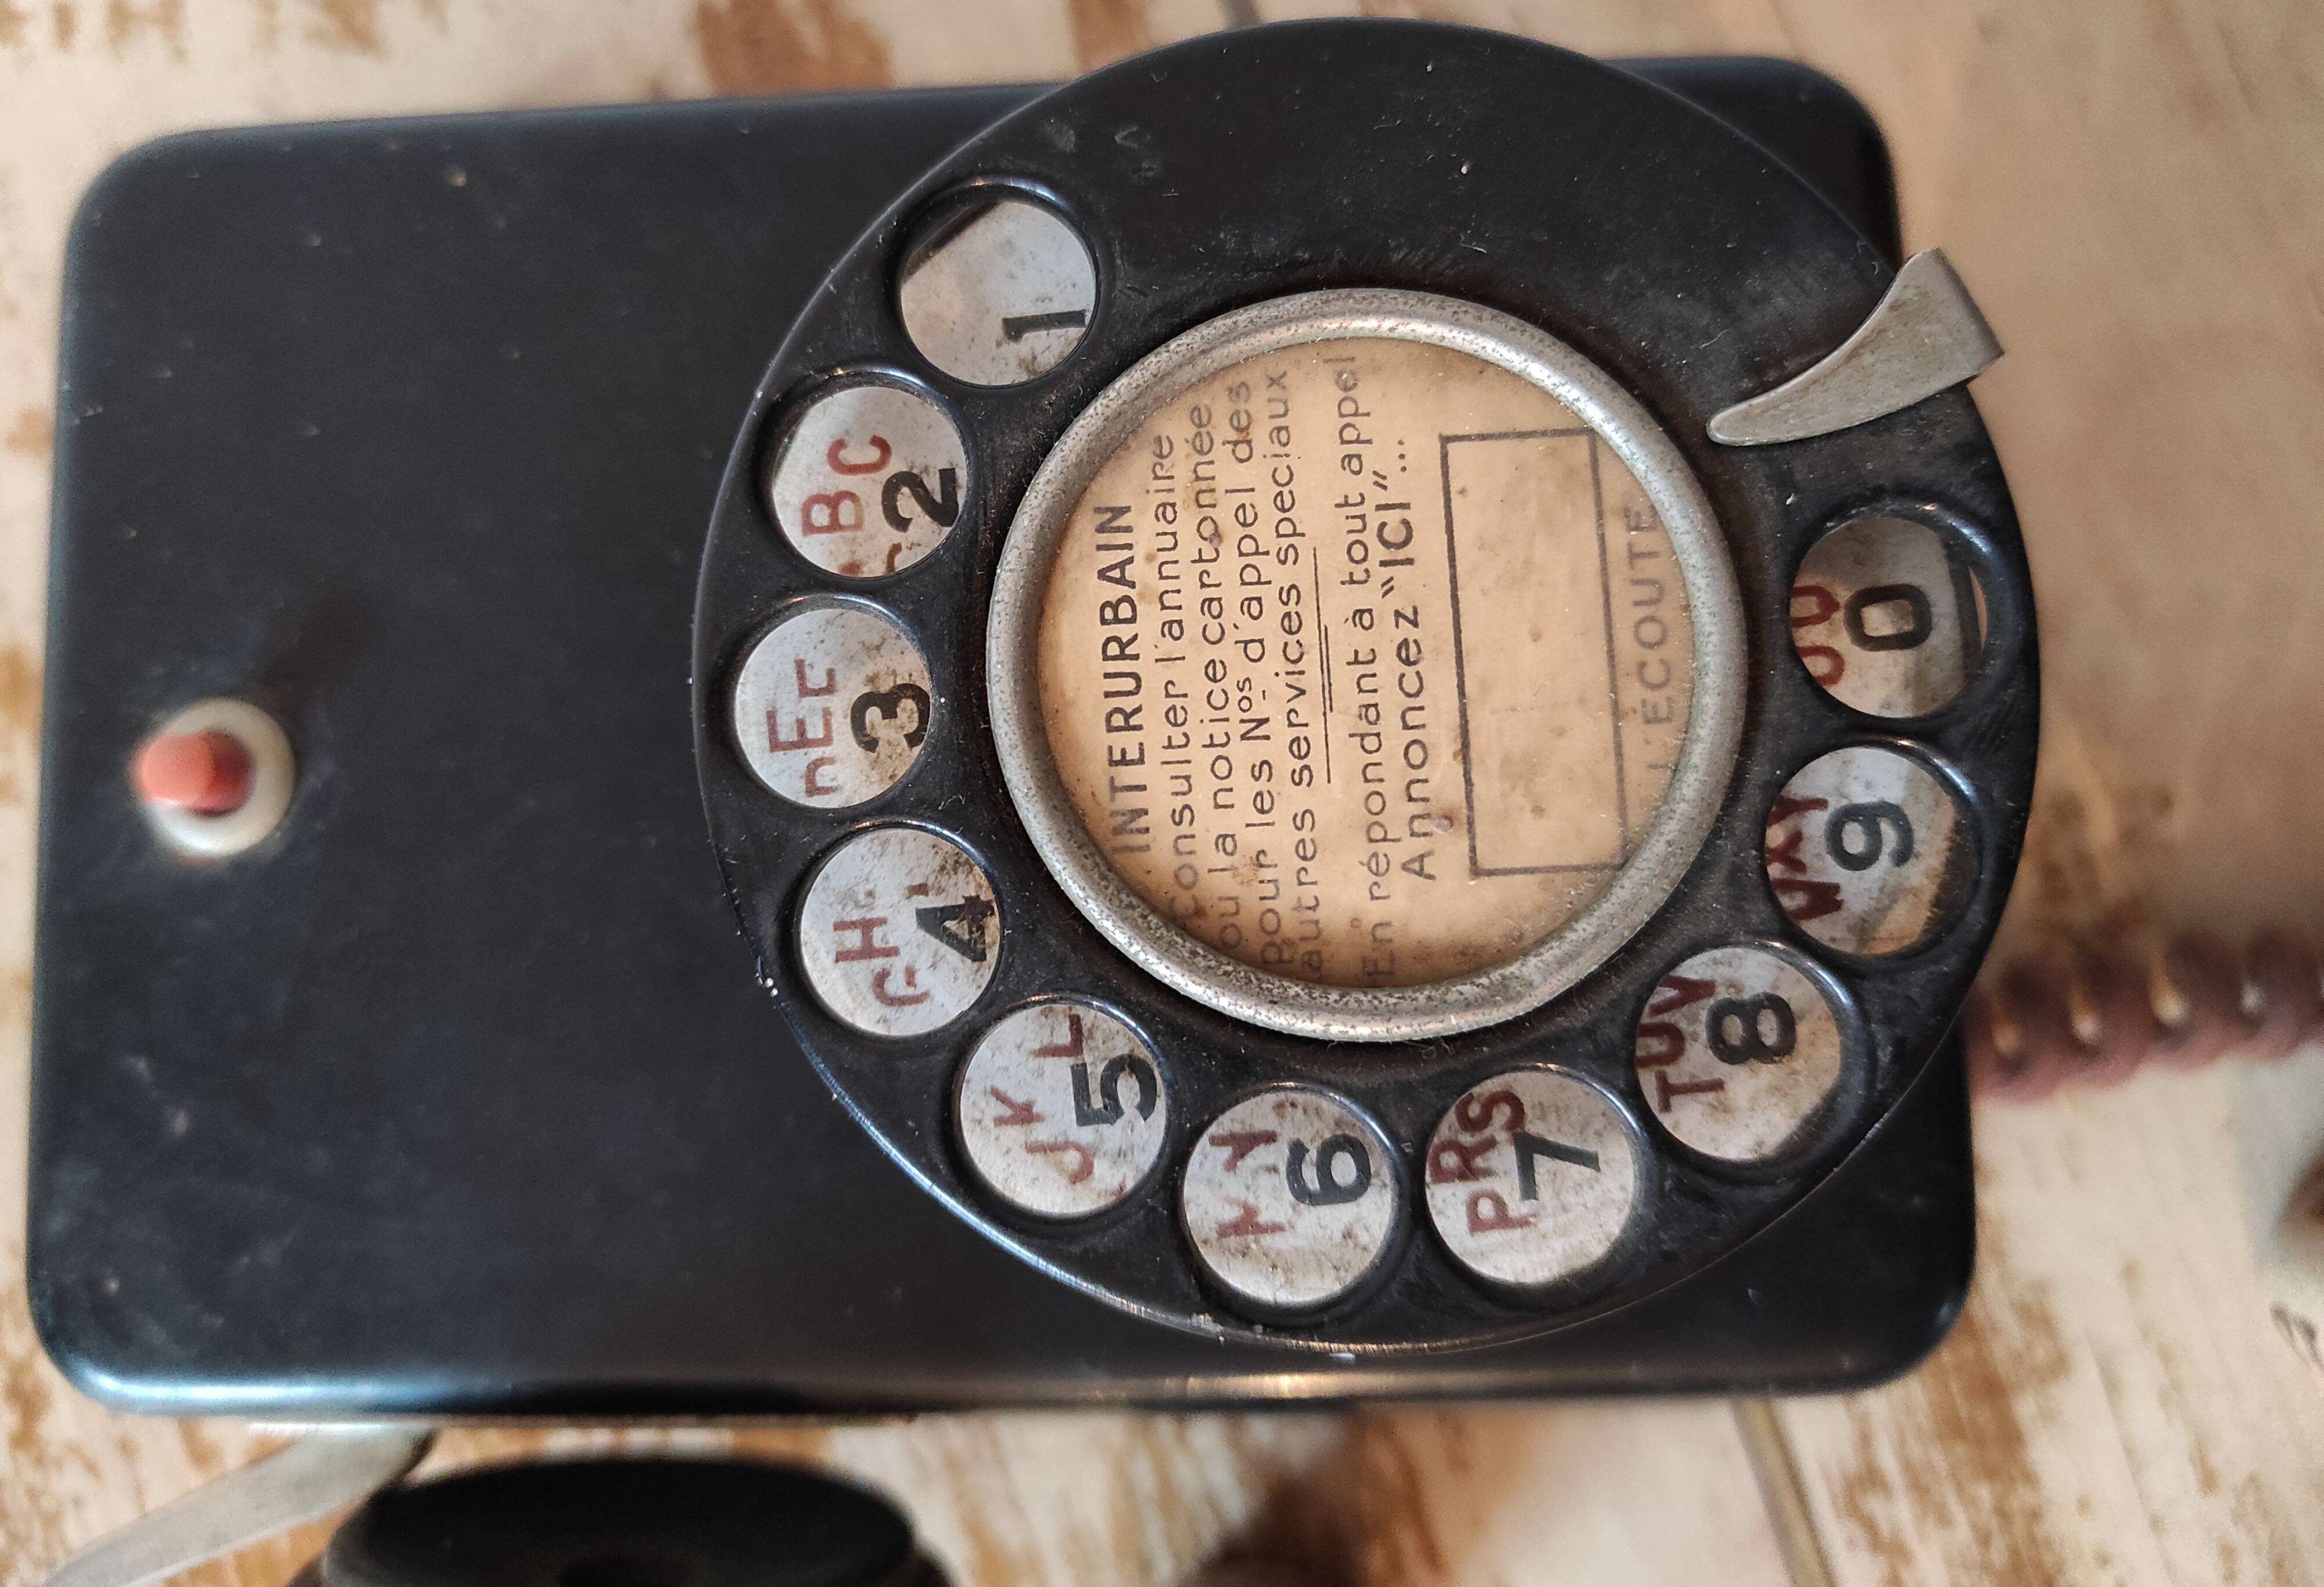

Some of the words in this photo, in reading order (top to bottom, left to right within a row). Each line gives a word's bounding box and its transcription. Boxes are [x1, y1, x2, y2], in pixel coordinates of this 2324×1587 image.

[1002, 309, 1086, 343] 1
[1222, 380, 1253, 463] des
[1323, 353, 1372, 475] appel
[801, 435, 902, 576] BC
[882, 468, 959, 533] 2
[1184, 403, 1225, 644] cartonnée
[1334, 492, 1370, 584] tout
[1145, 435, 1185, 663] l'annuaire
[1225, 486, 1271, 662] d'appel
[1343, 607, 1374, 631] à
[1845, 584, 1932, 651] 0
[850, 683, 931, 753] 3
[1093, 504, 1150, 854] INTERURBAIN
[1274, 583, 1312, 787] services
[1199, 658, 1234, 809] notice
[1346, 648, 1403, 900] répondant
[1393, 606, 1435, 880] Annoncez
[1160, 679, 1199, 918] Consulter
[1245, 760, 1275, 827] les
[1824, 800, 1914, 871] 9
[1207, 832, 1237, 873] la
[1290, 808, 1322, 968] autres
[832, 883, 930, 1007] GH
[916, 894, 995, 962] 4
[1218, 895, 1243, 948] ou
[1256, 849, 1293, 963] pour
[1362, 920, 1395, 976] En
[1635, 973, 1724, 1113] TUV
[1706, 992, 1796, 1066] 8
[1071, 1052, 1157, 1127] 5
[1286, 1134, 1371, 1206] 6
[1427, 1089, 1536, 1236] PRS
[1513, 1131, 1601, 1202] 7
